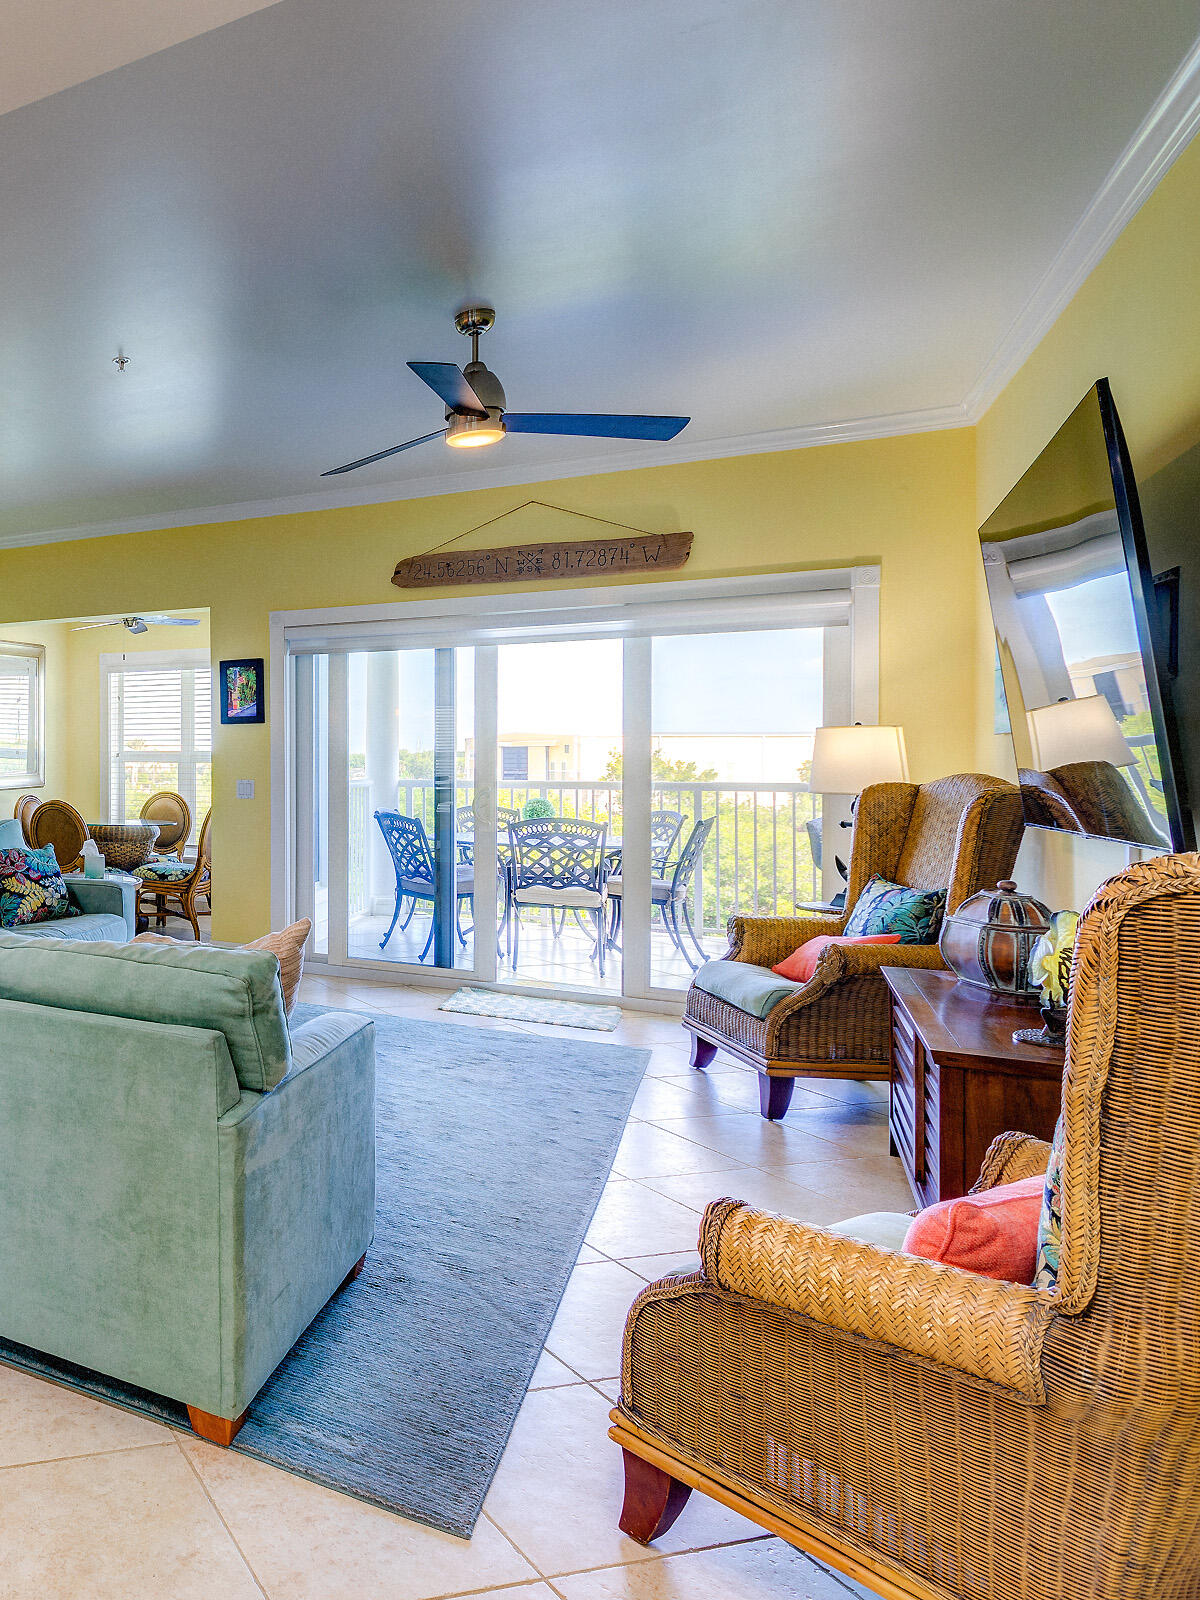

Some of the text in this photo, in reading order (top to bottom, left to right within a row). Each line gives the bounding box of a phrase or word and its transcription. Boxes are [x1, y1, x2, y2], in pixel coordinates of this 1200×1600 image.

[495, 556, 511, 574] N
[551, 542, 635, 570] 81.72874°
[641, 544, 662, 563] W
